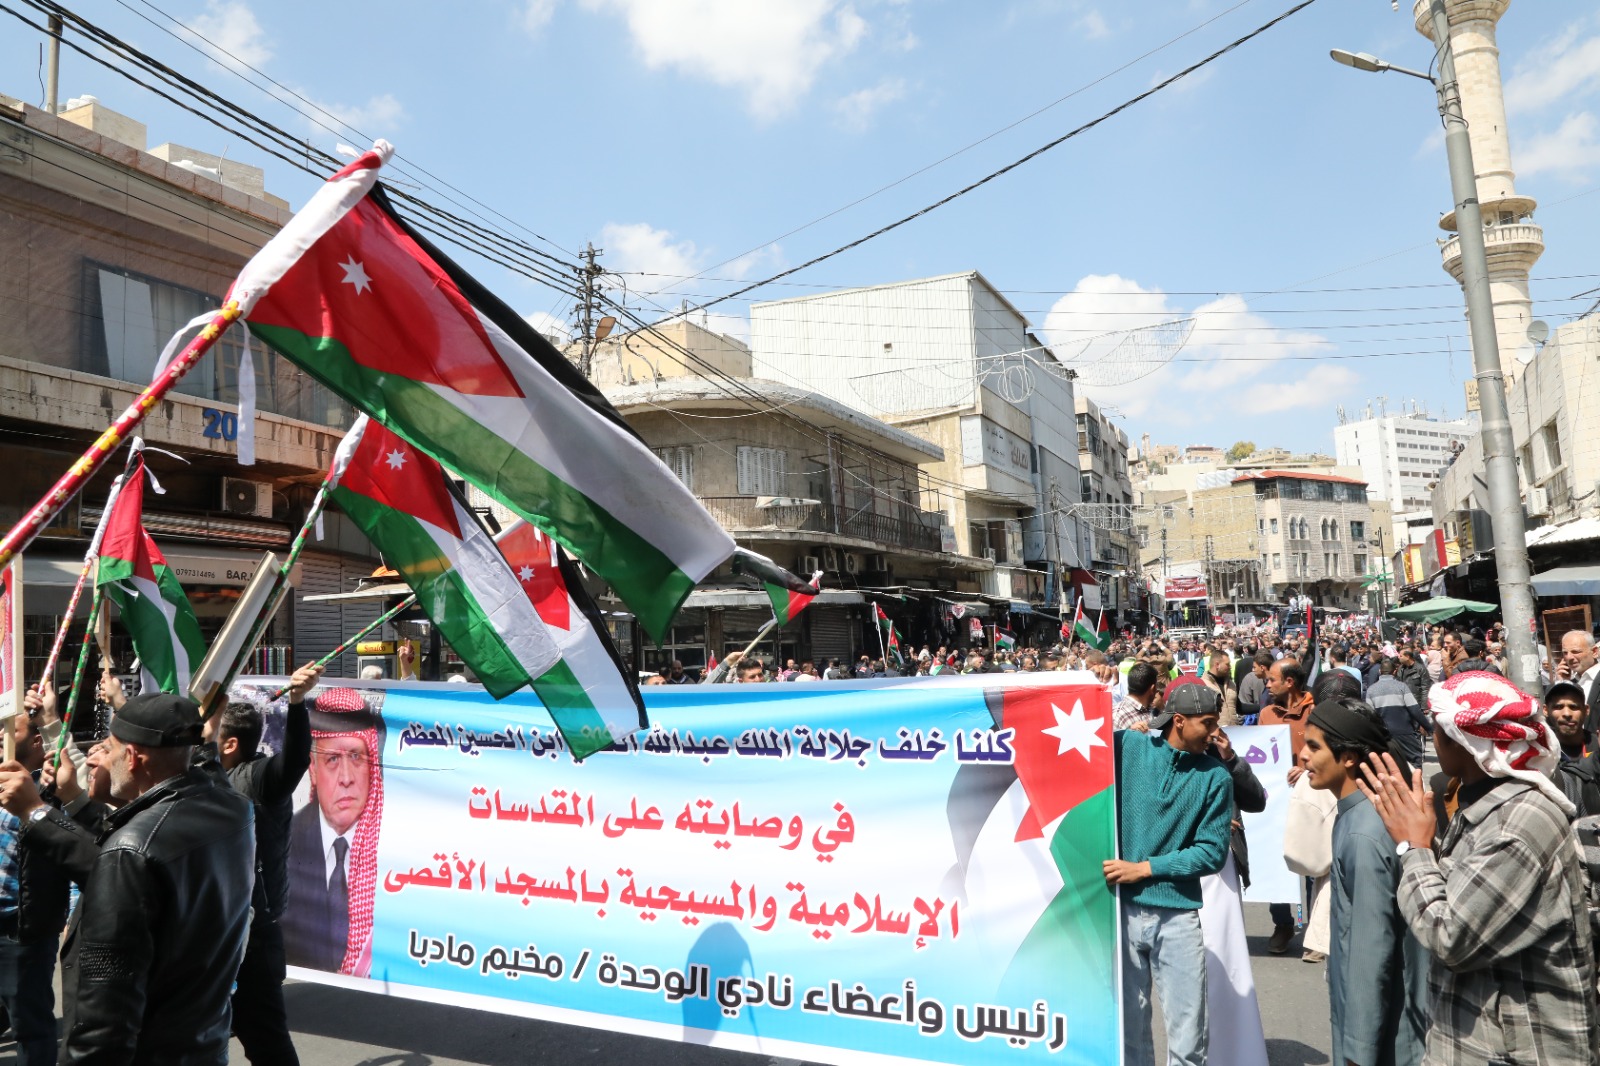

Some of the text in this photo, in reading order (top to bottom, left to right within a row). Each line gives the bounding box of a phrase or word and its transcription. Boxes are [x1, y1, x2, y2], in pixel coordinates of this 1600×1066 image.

[203, 408, 238, 441] 20
[399, 722, 453, 753] المعظم
[459, 723, 526, 757] الحسين
[531, 728, 564, 759] ابن
[736, 728, 791, 760] الملك
[796, 727, 872, 767] جلالة
[881, 729, 946, 760] خلف
[957, 730, 1013, 762] كلنا
[469, 786, 855, 863] في وصايته على المقدسات
[384, 852, 960, 951] الإسلامية والمسيحية بالمسجد الأقصى
[409, 931, 1066, 1049] رئيس وأعضاء نادي الوحدة / مخيم مادبا
